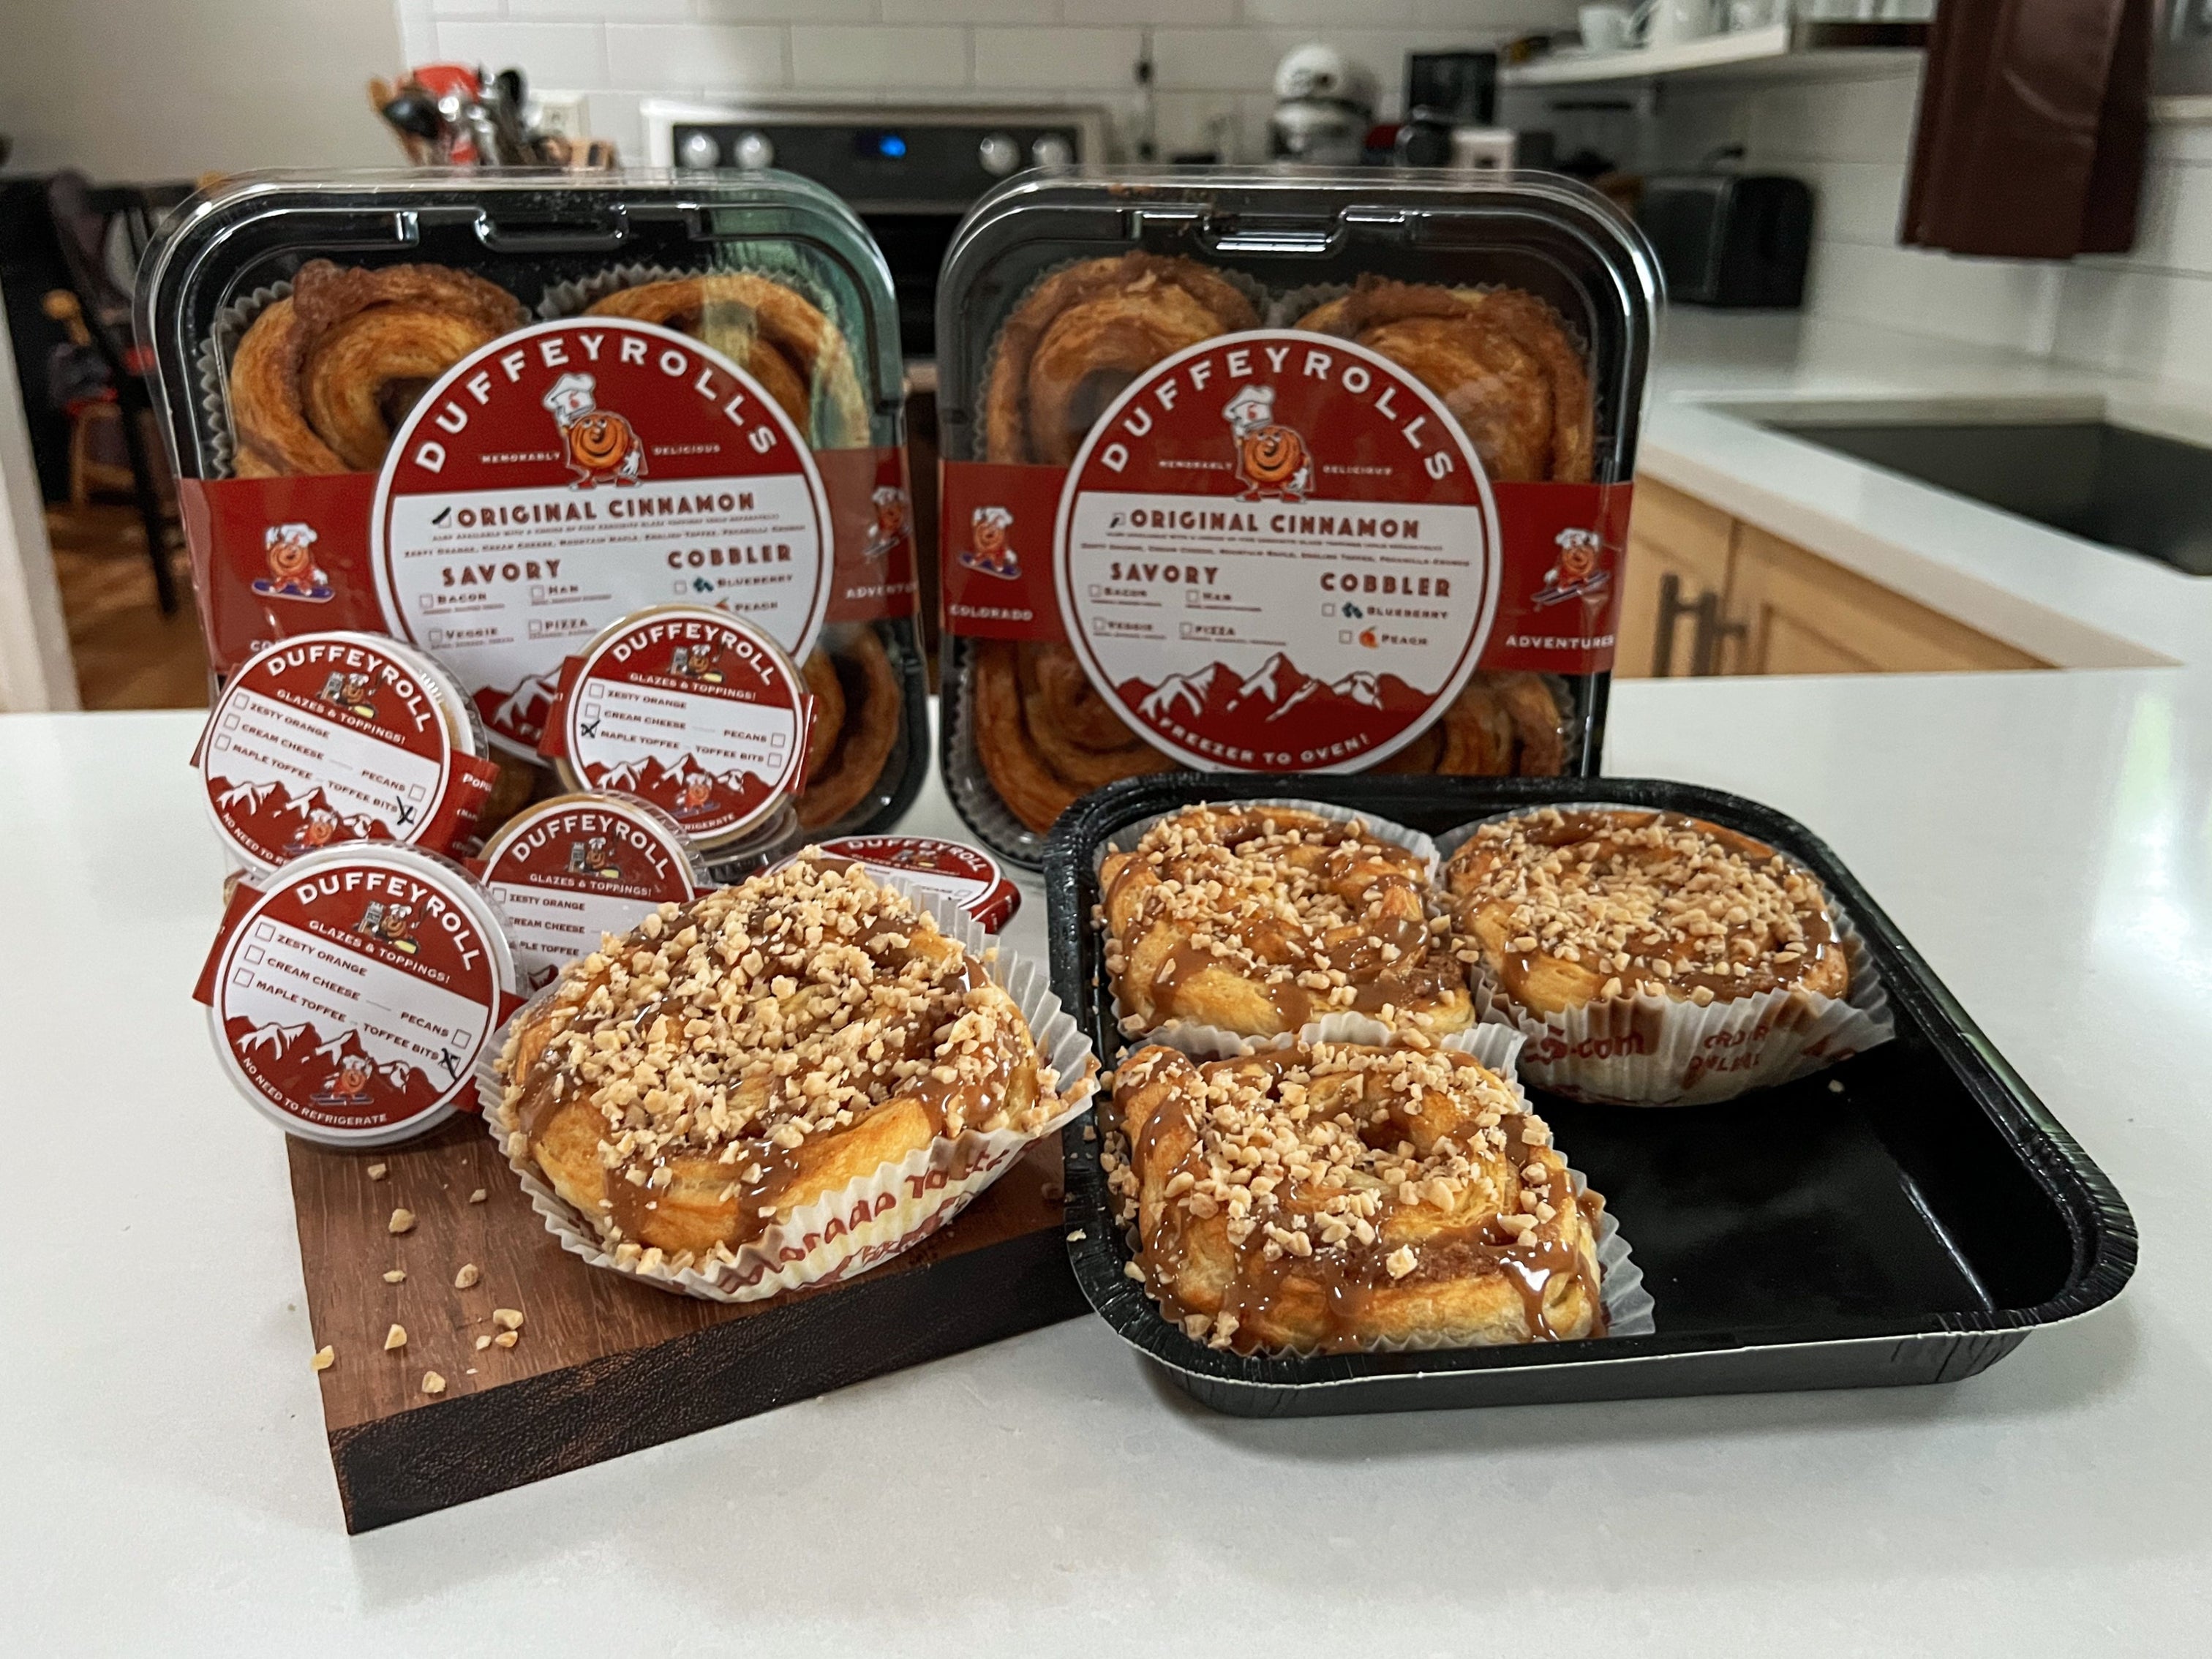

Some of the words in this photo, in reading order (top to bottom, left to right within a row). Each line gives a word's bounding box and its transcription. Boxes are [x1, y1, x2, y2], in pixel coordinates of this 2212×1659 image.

[415, 334, 777, 473] DUFFEYROLLS
[1100, 347, 1453, 481] DUFFEYROLLS
[481, 451, 561, 464] MEMORABLY
[652, 443, 721, 456] DELICIOUS
[458, 500, 597, 527] ORIGINAL
[609, 492, 754, 518] CINNAMON
[1131, 509, 1258, 532] ORIGINAL
[1270, 514, 1419, 539] CINNAMON
[668, 543, 791, 569] COBBLER
[442, 559, 561, 587] SAVORY
[718, 574, 793, 587] BLUEBERRY
[1110, 562, 1219, 584] SAVORY
[1320, 572, 1450, 597] COBBLER
[437, 592, 486, 604] BACON
[734, 601, 778, 612] PEACH
[546, 618, 589, 630] PIZZA
[949, 604, 1033, 621] COLORADO
[1367, 606, 1448, 619] BLUEBERRY
[446, 628, 499, 639] VEGGIE
[1382, 633, 1428, 645] PEACH
[612, 622, 775, 686] DUFFEYROLL
[267, 644, 432, 732] DUFFEYROLL
[607, 690, 641, 702] ZESTY
[642, 695, 687, 710] ORANGE
[629, 672, 677, 690] GLAZES
[680, 680, 690, 690] &
[691, 681, 757, 701] TOPPINGS!
[249, 703, 283, 721] ZESTY
[284, 715, 330, 739] ORANGE
[276, 688, 326, 714] GLAZES
[327, 707, 337, 718] &
[340, 712, 406, 745] TOPPINGS!
[604, 710, 643, 724] CREAM
[644, 715, 686, 730] CHEESE
[241, 723, 279, 745] CREAM
[279, 738, 325, 761] CHEESE
[600, 730, 639, 745] MAPLE
[639, 736, 680, 750] TOFFEE
[723, 729, 767, 743] PECANS
[1159, 717, 1254, 762] FREEZER
[1263, 751, 1293, 765] TO
[1300, 732, 1371, 762] OVEN!
[232, 743, 271, 767] MAPLE
[271, 756, 314, 780] TOFFEE
[695, 745, 738, 759] TOFFEE
[740, 752, 765, 763] BITS
[361, 770, 406, 793] PECANS
[327, 780, 371, 802] TOFFEE
[372, 797, 399, 814] BITS
[222, 812, 236, 829] NO
[234, 827, 260, 851] NEED
[260, 847, 274, 860] TO
[512, 813, 672, 880] DUFFEYROLL
[530, 873, 576, 887] GLAZES
[578, 879, 587, 888] &
[590, 880, 652, 897] TOPPINGS!
[510, 894, 541, 905] ZESTY
[542, 898, 586, 911] ORANGE
[296, 872, 481, 971] DUFFEYROLL
[544, 922, 586, 934] CHEESE
[276, 933, 315, 955] ZESTY
[317, 950, 368, 977] ORANGE
[309, 919, 362, 949] GLAZES
[365, 941, 375, 953] &
[379, 947, 451, 985] TOPPINGS!
[541, 944, 580, 956] TOFFEE
[267, 957, 310, 981] CREAM
[312, 974, 361, 1001] CHEESE
[255, 979, 298, 1004] MAPLE
[299, 996, 347, 1023] TOFFEE
[399, 1011, 450, 1039] PECANS
[363, 1022, 410, 1049] TOFFEE
[412, 1042, 440, 1061] BITS
[243, 1056, 258, 1075] NO
[257, 1072, 283, 1102] NEED
[282, 1096, 298, 1111] TO
[300, 1105, 388, 1126] REFRIGERATE
